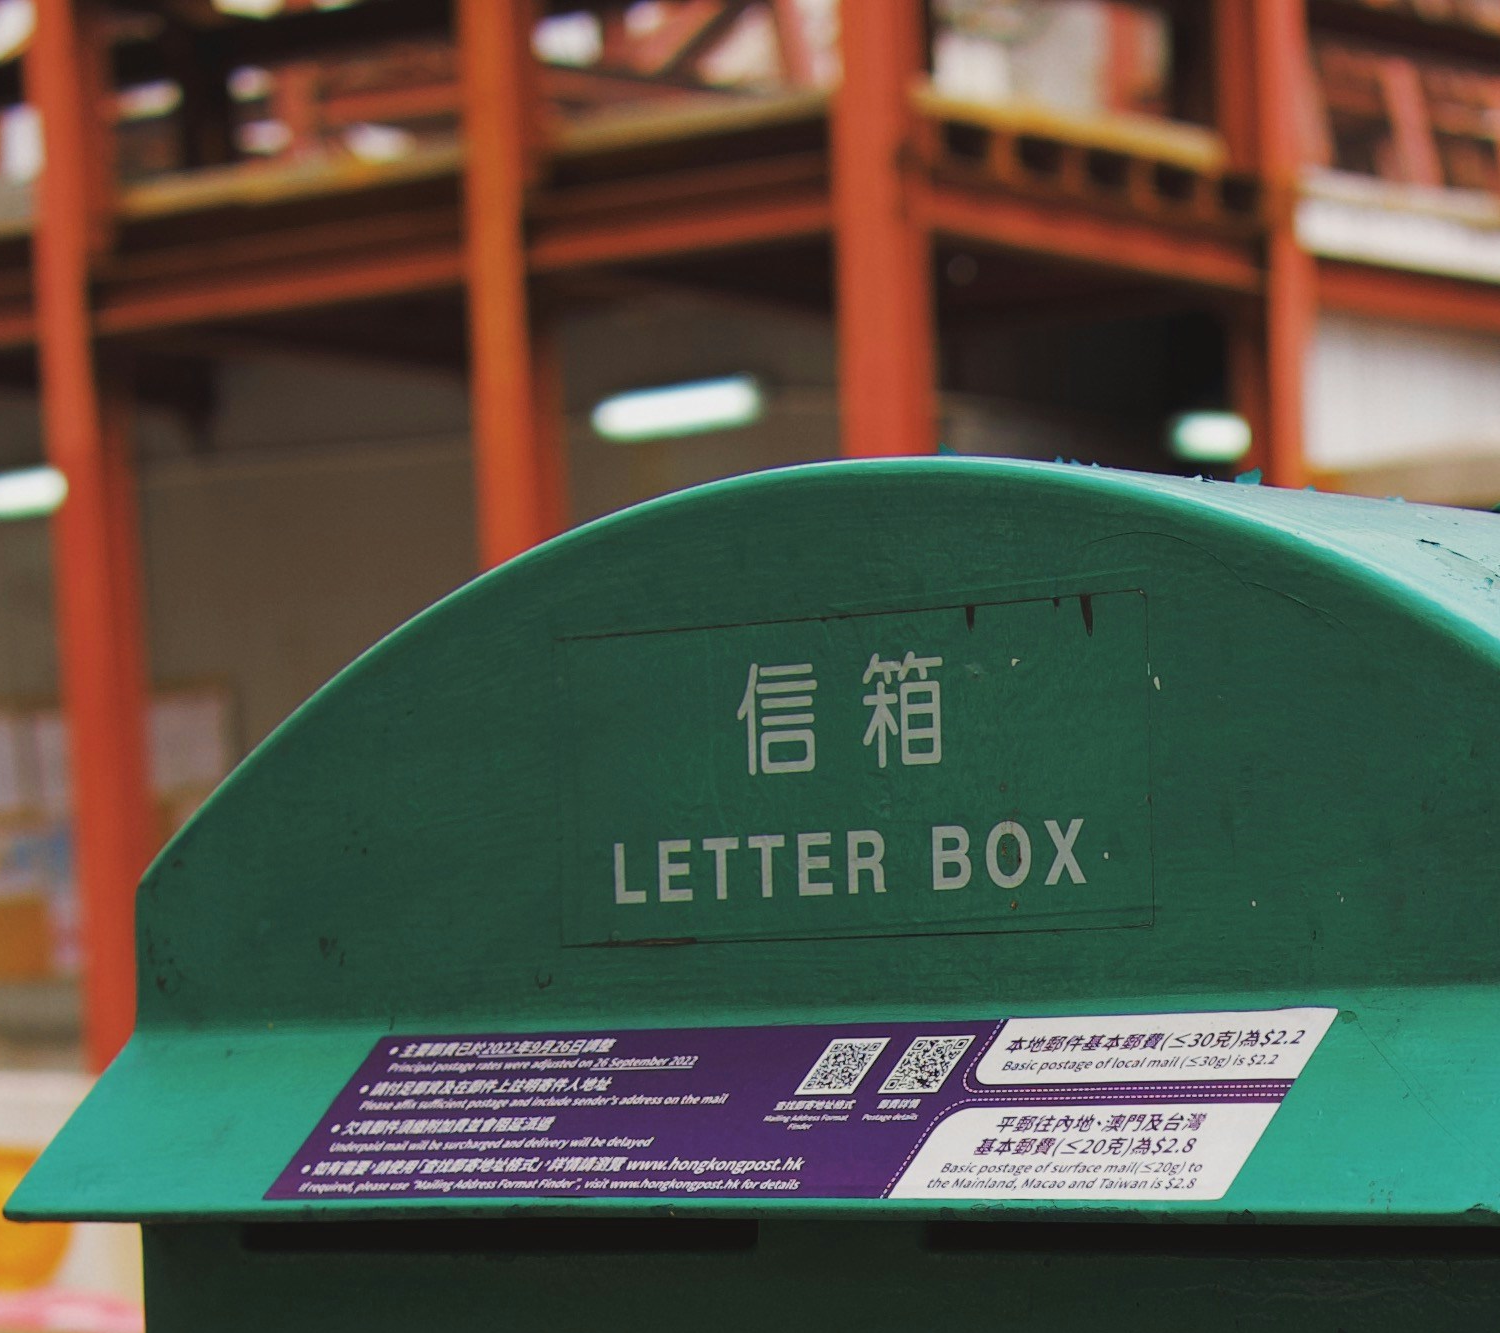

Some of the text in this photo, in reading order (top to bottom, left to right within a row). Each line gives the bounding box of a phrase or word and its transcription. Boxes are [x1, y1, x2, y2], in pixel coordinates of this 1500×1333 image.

[737, 651, 943, 775] 信箱
[614, 818, 1088, 904] LETTER BOX
[1002, 1060, 1037, 1072] Basic
[1037, 1059, 1093, 1074] postage
[1095, 1058, 1113, 1070] of
[1113, 1058, 1146, 1069] local
[1148, 1057, 1178, 1068] mail
[1234, 1055, 1245, 1065] is
[1247, 1053, 1279, 1067] $2.2
[627, 1156, 805, 1175] www.hongkongpost.hk
[940, 1163, 977, 1174] Basic
[979, 1163, 1032, 1177] postage
[1035, 1162, 1052, 1173] of
[1052, 1161, 1101, 1173] surface
[1188, 1163, 1203, 1172] to
[927, 1177, 1197, 1191] the Mainland, Macao and Taiwan is $2.8
